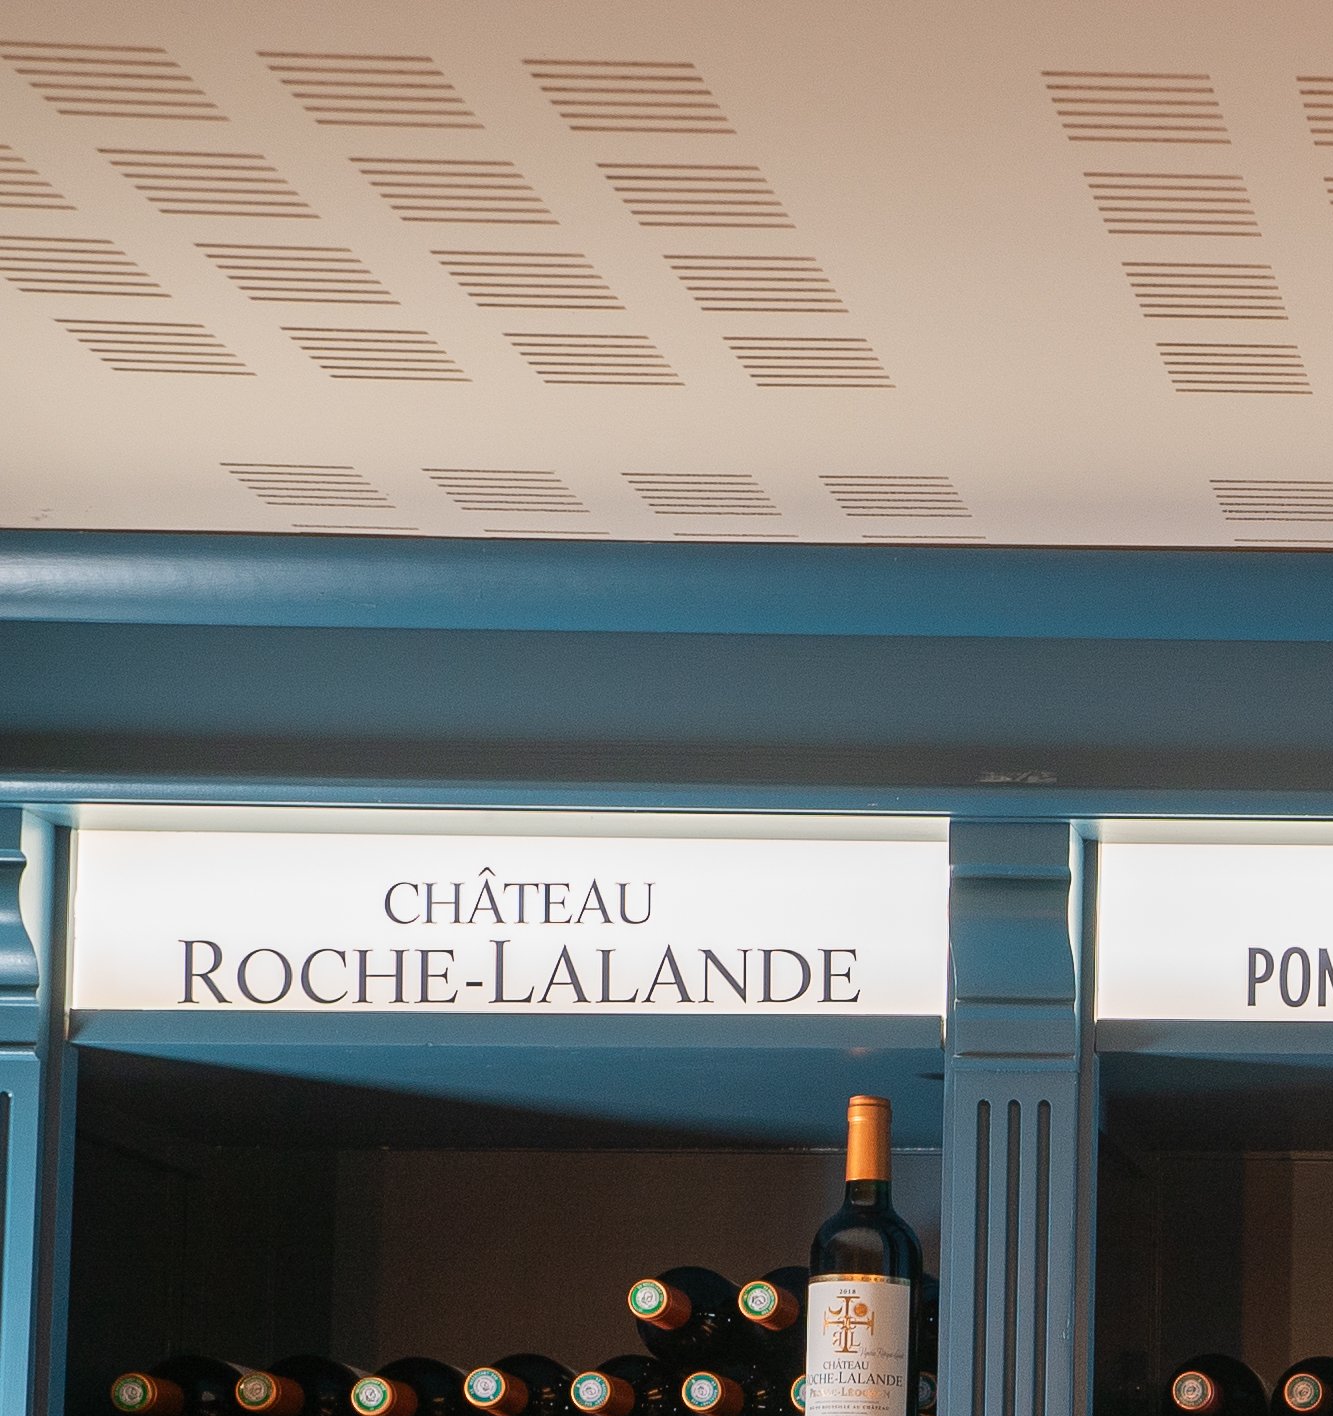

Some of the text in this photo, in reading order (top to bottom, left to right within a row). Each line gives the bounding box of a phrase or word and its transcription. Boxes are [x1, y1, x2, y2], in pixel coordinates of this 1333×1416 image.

[384, 866, 655, 925] CHÂTEAU
[176, 938, 862, 1005] ROCHE-LALANDE
[808, 1372, 903, 1388] OCHE-LALANDE
[822, 1358, 870, 1371] CHÂTEAU
